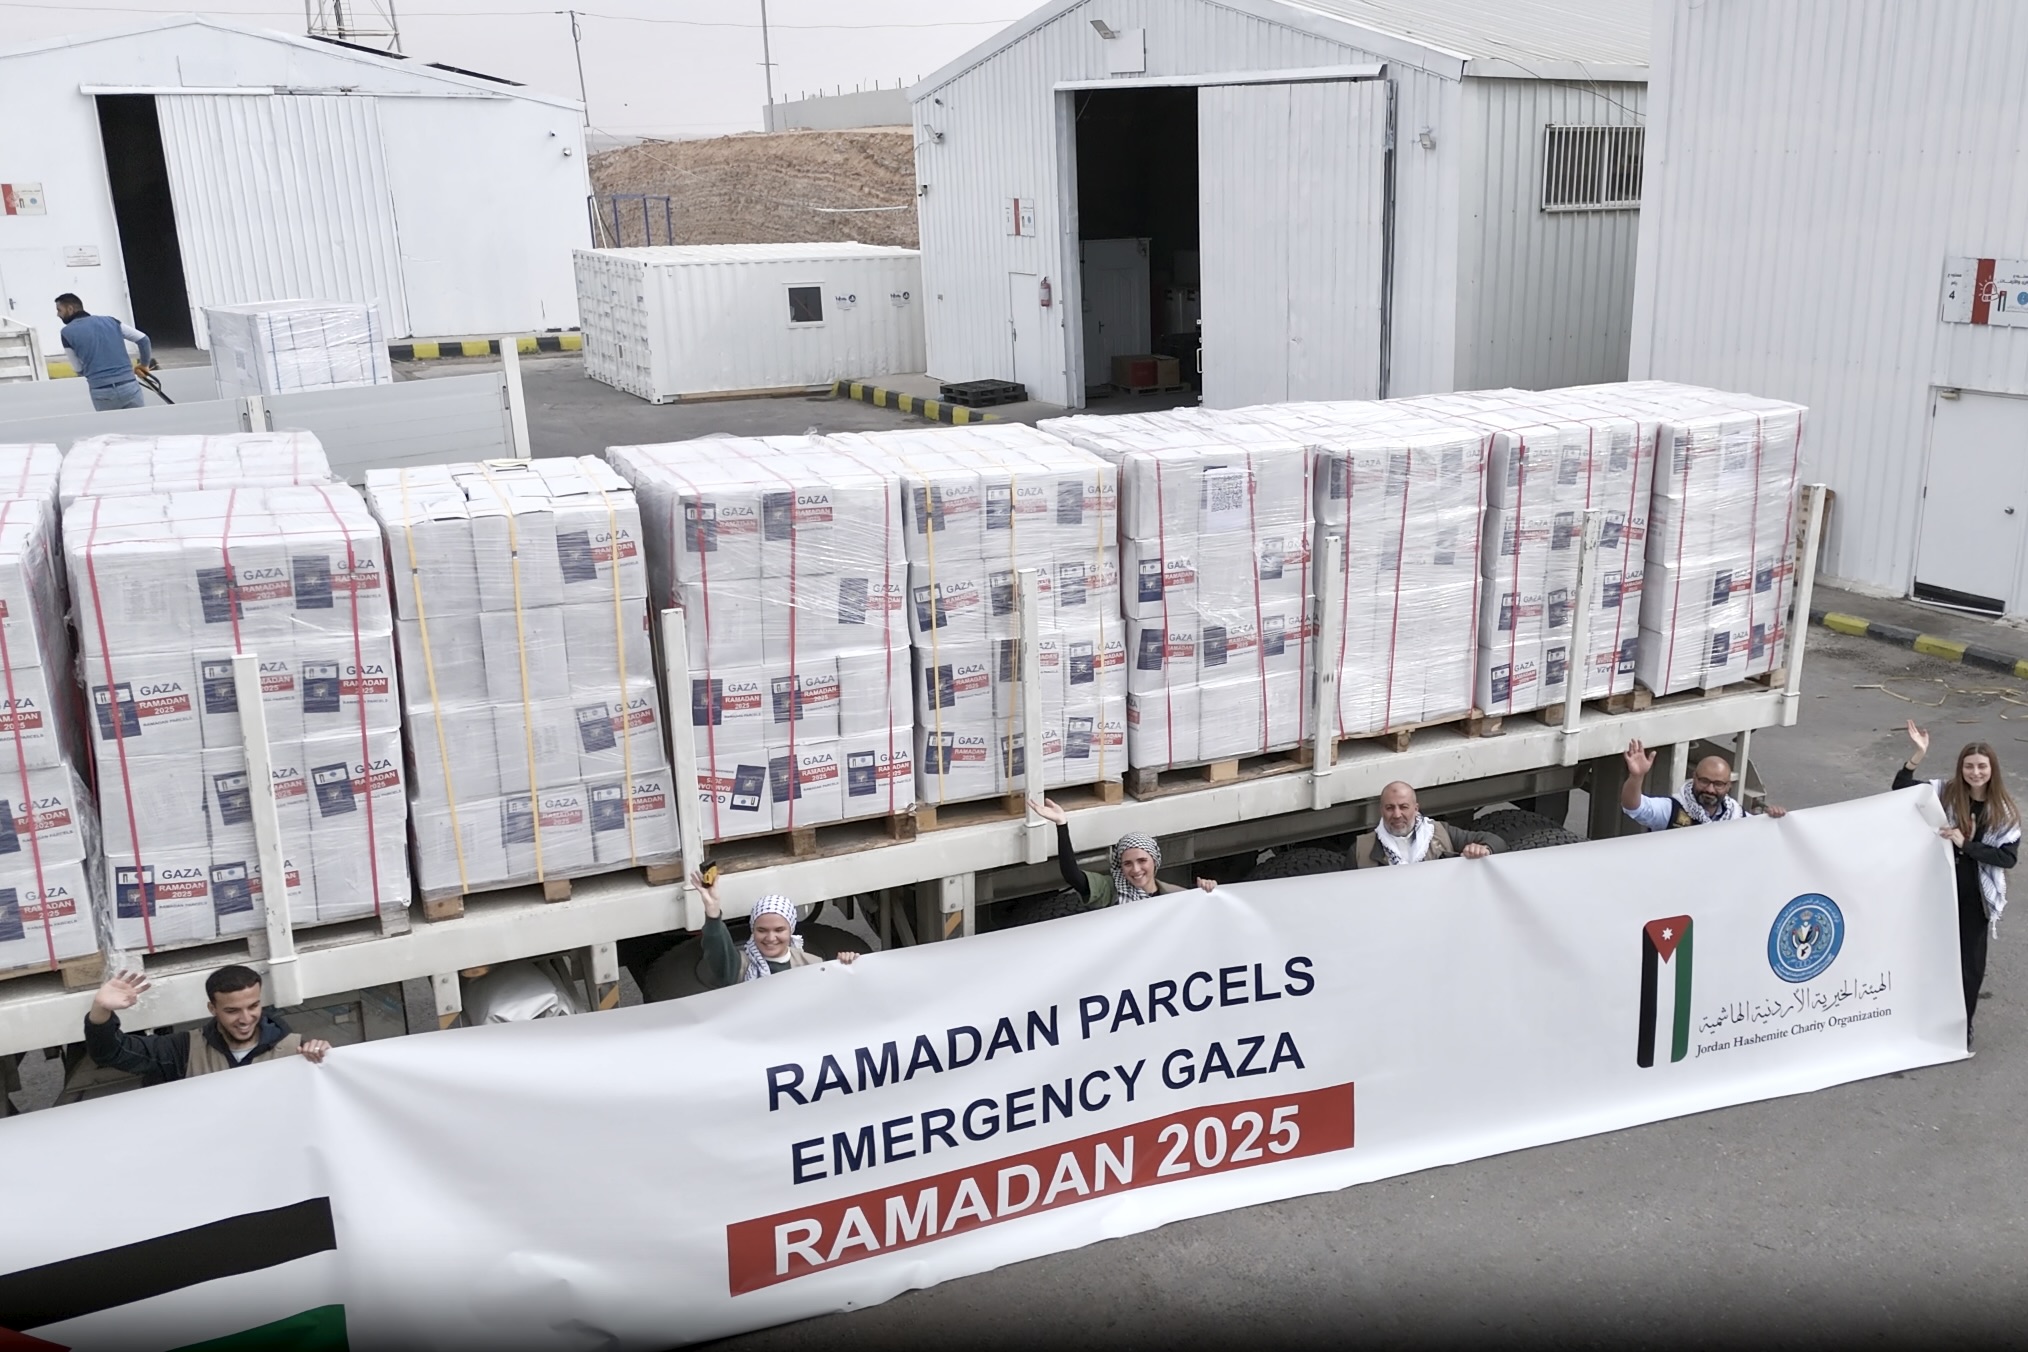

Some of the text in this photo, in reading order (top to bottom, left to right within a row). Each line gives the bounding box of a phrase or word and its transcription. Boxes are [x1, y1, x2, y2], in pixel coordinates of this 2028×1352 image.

[1949, 290, 1955, 299] 4
[945, 485, 975, 497] GAZA
[1016, 487, 1044, 496] GAZA
[797, 495, 829, 505] GAZA
[722, 507, 754, 517] GAZA
[243, 567, 284, 581] GAZA
[242, 582, 288, 593] RAMADAN
[946, 581, 974, 593] GAZA
[257, 592, 277, 600] 2025
[259, 662, 288, 672] AZA
[958, 664, 985, 675] GAZA
[1514, 661, 1534, 672] GAZA
[806, 675, 835, 686] GAZA
[956, 675, 987, 685] RAMADAN
[140, 683, 182, 696] GAZA
[728, 682, 758, 692] GAZA
[804, 686, 837, 697] RAMADAN
[0, 698, 34, 709] AZA
[139, 696, 186, 709] RAMADAN
[725, 695, 760, 703] RAMADAN
[154, 706, 175, 715] 2025
[735, 702, 750, 710] 2025
[958, 737, 985, 745] GAZA
[803, 753, 833, 766] GAZA
[271, 767, 298, 779] AZA
[801, 765, 836, 777] RAMADAN
[811, 773, 827, 781] 2025
[545, 798, 579, 809] GAZA
[628, 795, 663, 805] AMADAN
[162, 868, 203, 880] GAZA
[159, 882, 205, 892] RAMADAN
[172, 890, 192, 898] 2025
[1859, 971, 1891, 1000] الهيئة
[1812, 978, 1857, 1012] الخيرية
[1699, 1001, 1749, 1034] الهاشمية
[765, 956, 1315, 1111] RAMADAN PARCELS
[1695, 1006, 1892, 1058] Jordan Hashemite Charity Organization
[791, 1031, 1305, 1184] EMERGENCY GAZA
[774, 1105, 1301, 1276] RAMADAN 2025
